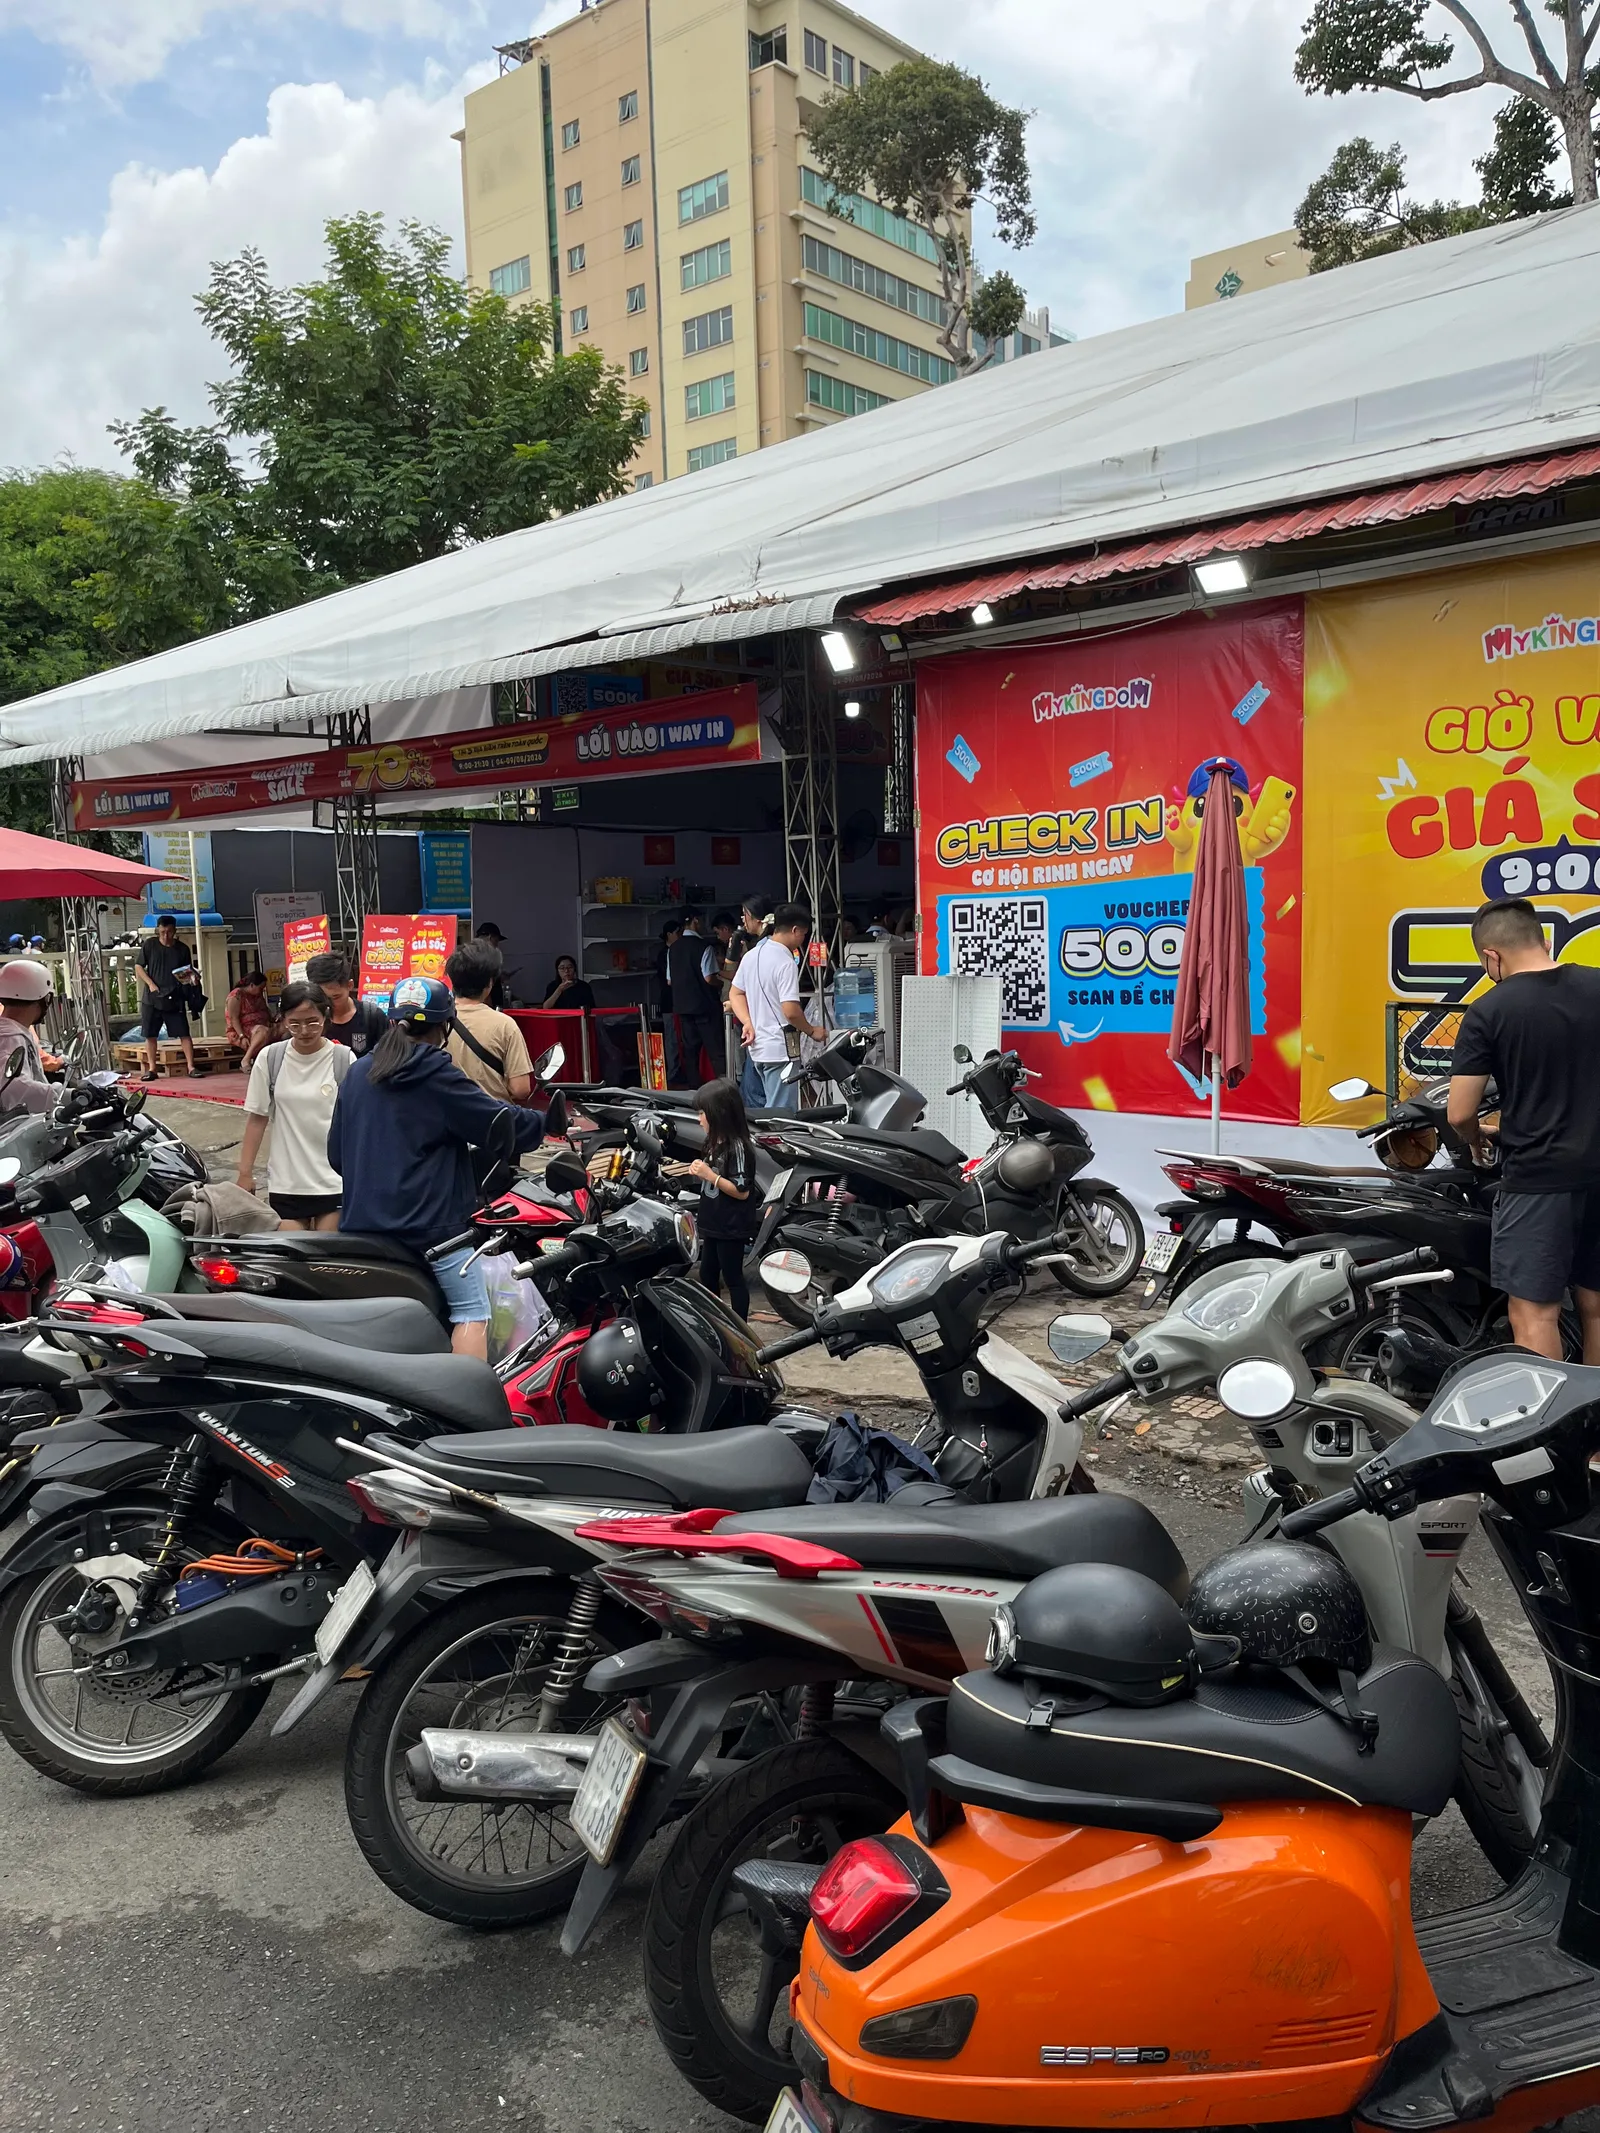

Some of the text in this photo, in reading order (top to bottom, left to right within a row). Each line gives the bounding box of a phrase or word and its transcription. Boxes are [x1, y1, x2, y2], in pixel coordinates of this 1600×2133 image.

[1483, 615, 1600, 661] MYKING
[1032, 677, 1152, 722] MYKINGDOM
[1237, 692, 1261, 718] 500K
[669, 721, 725, 743] WAY IN
[1425, 689, 1600, 753] GIỜ V
[577, 721, 659, 760] LỐI VÀO
[954, 744, 975, 771] 500K
[1073, 757, 1100, 778] 500K
[251, 762, 315, 781] WAREHOUSE
[134, 792, 170, 807] WAY OUT
[268, 776, 306, 802] SALE
[114, 795, 131, 814] RA
[1387, 756, 1543, 859] GIÁ
[937, 796, 1165, 865] CHECK IN
[972, 854, 1134, 890] CƠ HỘI RINH NGAY
[1499, 852, 1600, 895] 9:0
[1062, 924, 1187, 977] 500
[1068, 981, 1175, 1005] SCAN ĐỂ CH
[309, 1264, 369, 1276] VISION
[197, 1409, 275, 1467] QUANTUM
[1420, 1521, 1467, 1529] SPORT
[872, 1580, 999, 1598] VISION
[596, 1732, 634, 1797] 59-V3
[1040, 2045, 1169, 2064] ESPERO
